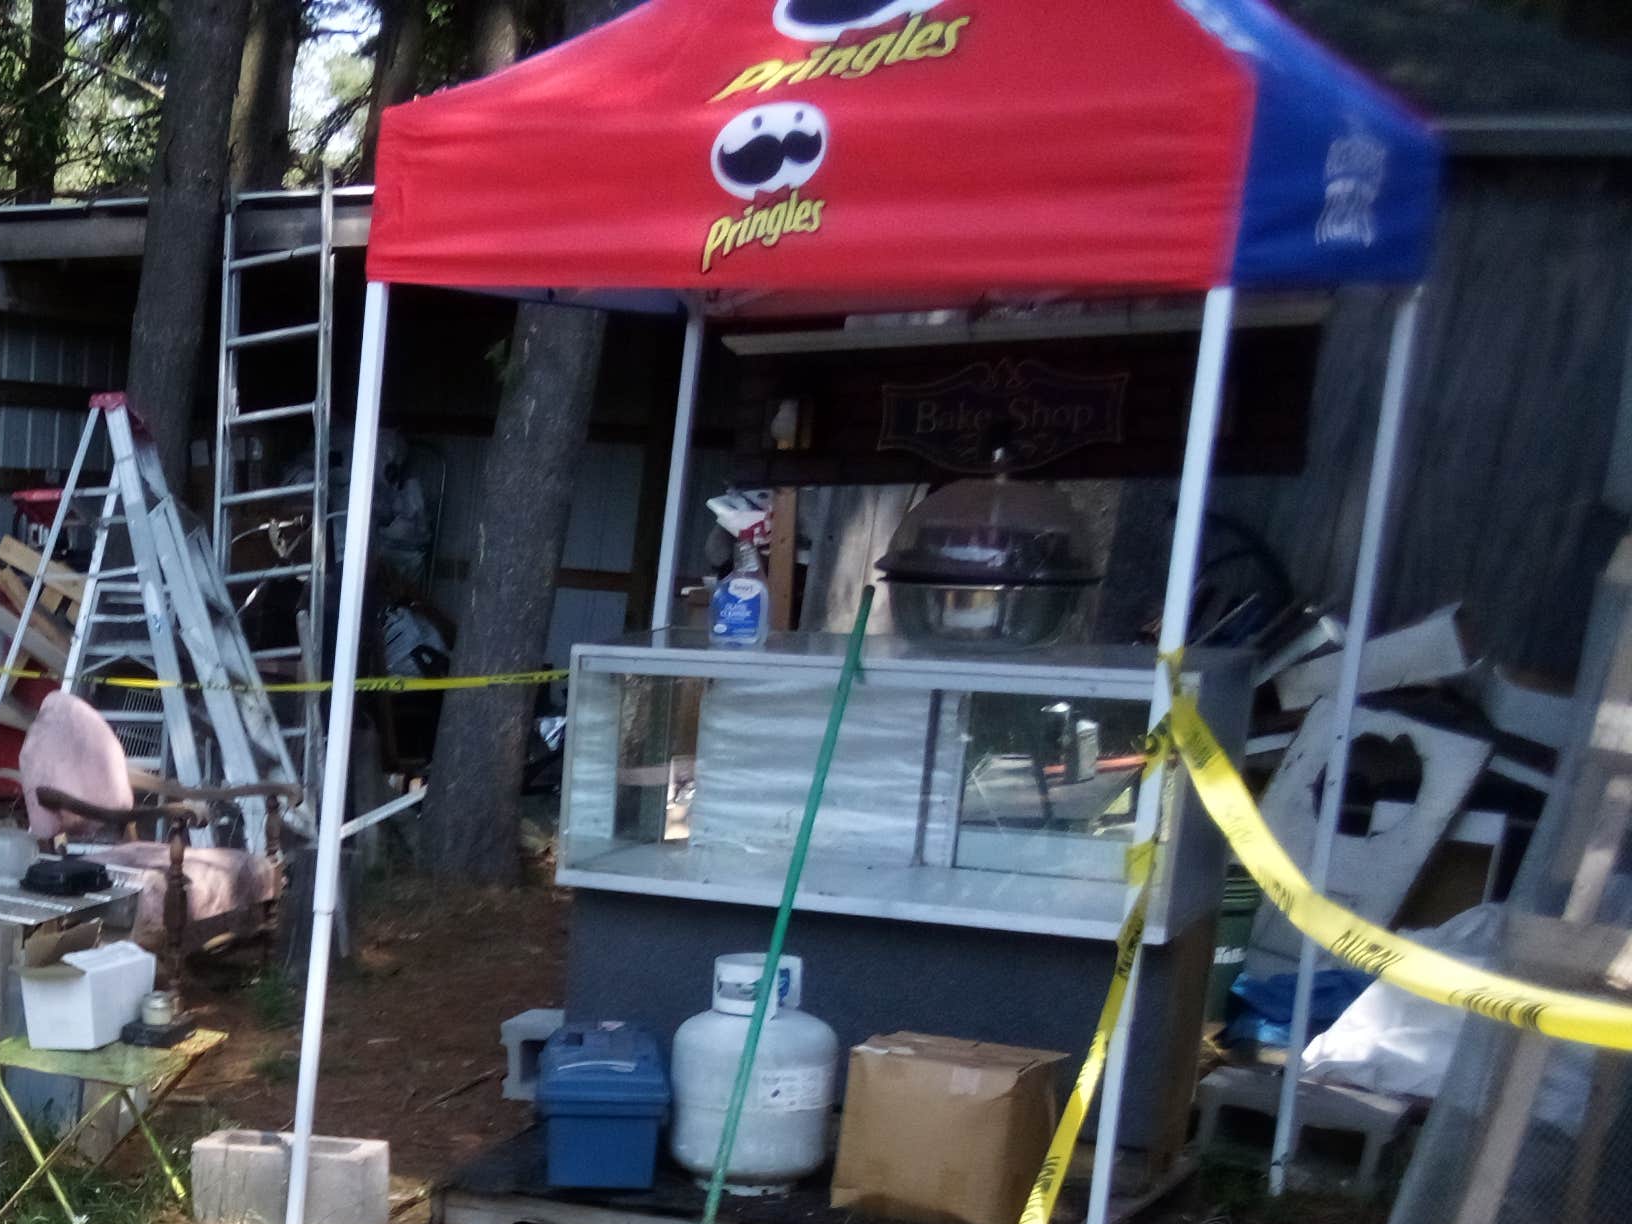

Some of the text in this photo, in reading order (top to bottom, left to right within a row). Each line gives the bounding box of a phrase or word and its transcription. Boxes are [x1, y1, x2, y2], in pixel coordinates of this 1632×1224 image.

[707, 14, 970, 103] Pringles
[701, 188, 825, 274] Pringles
[914, 396, 1095, 434] Bake Shop
